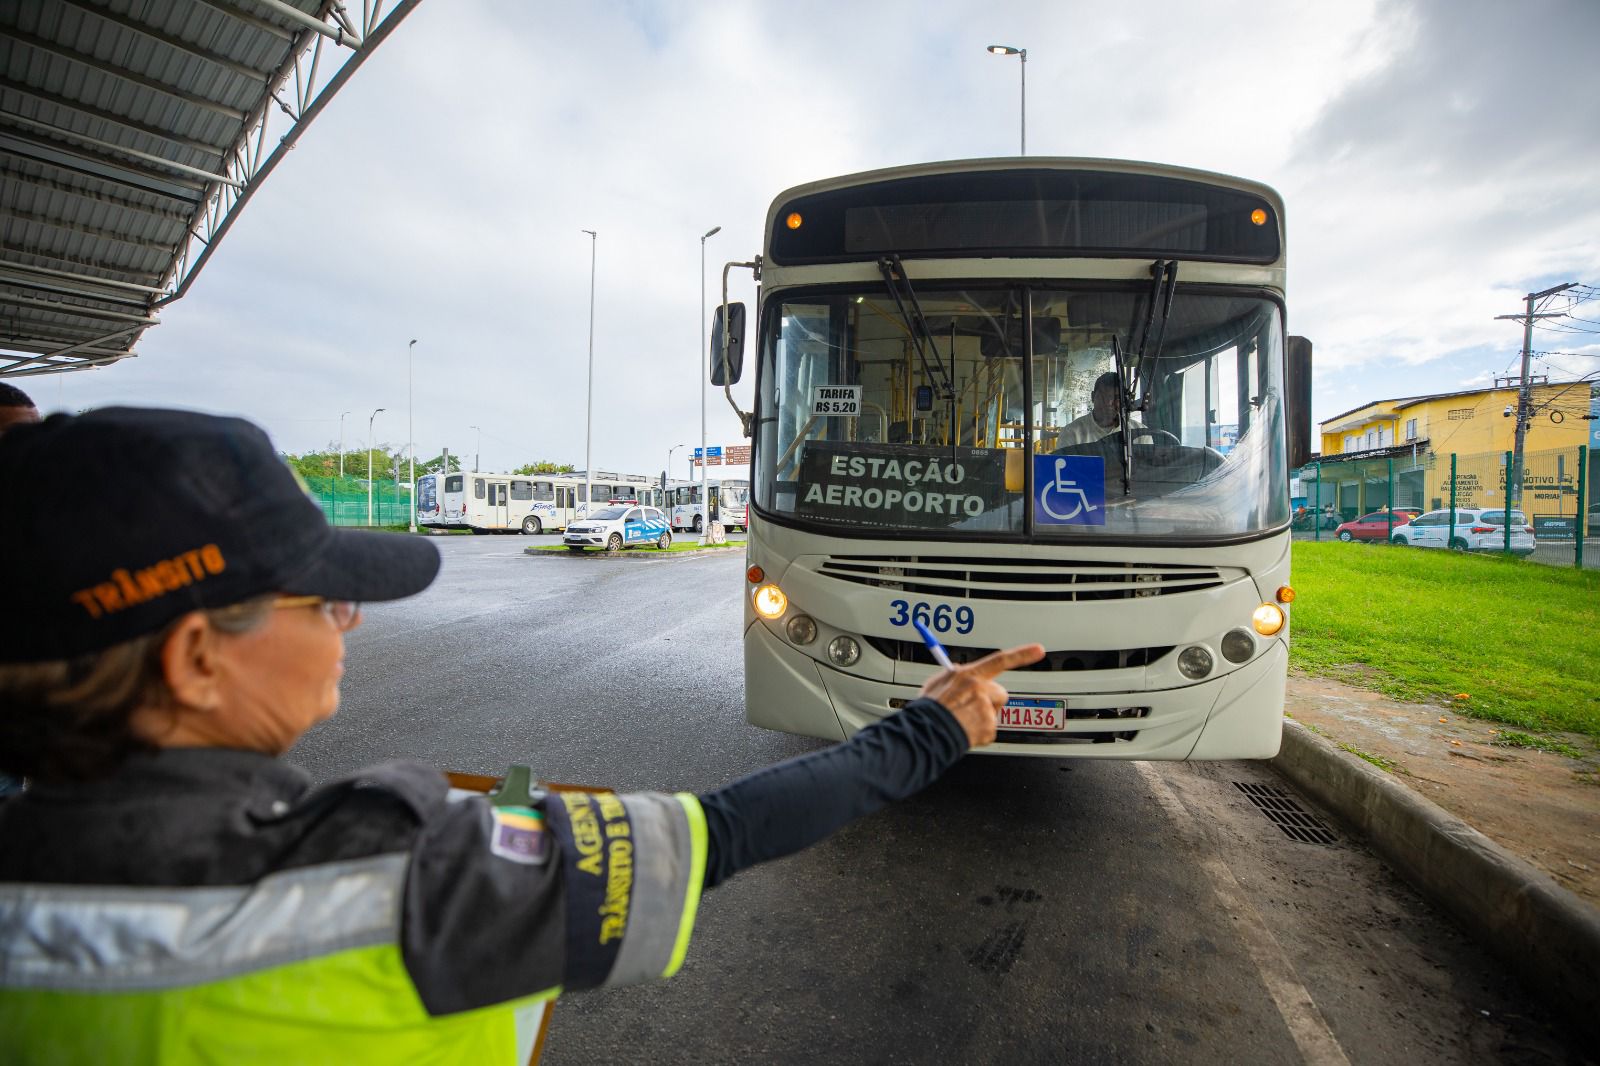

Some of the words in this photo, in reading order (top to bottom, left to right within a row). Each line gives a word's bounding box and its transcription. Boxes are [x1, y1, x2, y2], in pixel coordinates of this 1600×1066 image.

[819, 388, 855, 400] TARIFA
[815, 401, 830, 413] R$
[832, 402, 857, 414] 5,20
[829, 455, 966, 488] ESTAÇÃO
[804, 482, 986, 518] AEROPORTO
[888, 599, 975, 635] 3669
[1001, 708, 1055, 726] M1A36
